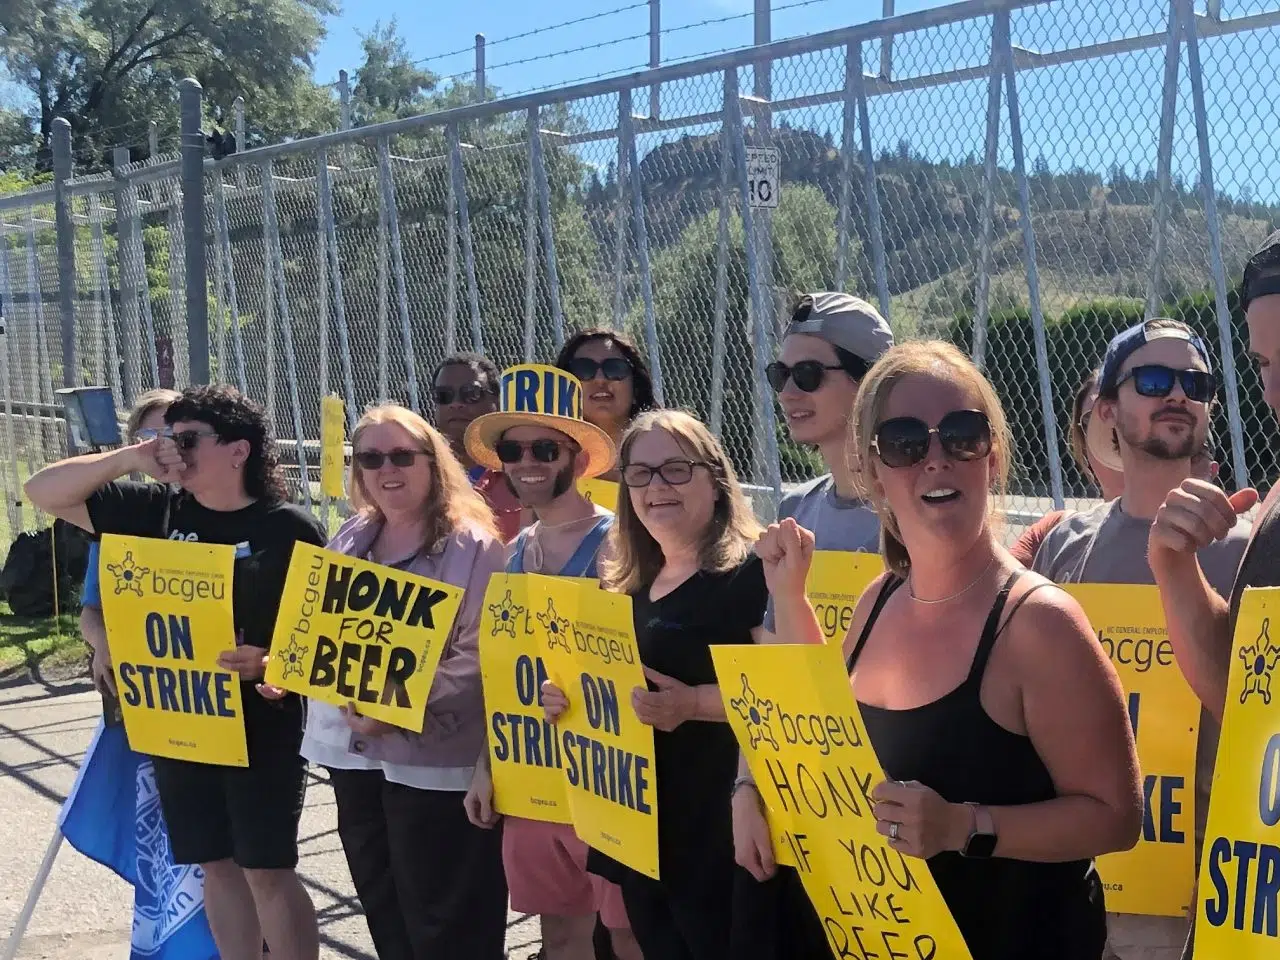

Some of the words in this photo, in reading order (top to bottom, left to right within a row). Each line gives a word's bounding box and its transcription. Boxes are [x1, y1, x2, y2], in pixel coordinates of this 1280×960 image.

[502, 370, 582, 419] TRIK
[153, 570, 225, 602] bcgeu
[294, 554, 324, 635] bcgeu
[321, 563, 448, 630] HONK
[145, 612, 194, 660] ON
[338, 617, 394, 645] FOR
[572, 623, 635, 665] bcgeu
[1098, 630, 1174, 672] bcge
[120, 662, 236, 718] STRIKE
[309, 635, 417, 709] BEER
[581, 672, 620, 736] ON
[776, 703, 863, 755] bcgeu
[492, 712, 562, 769] STRI
[563, 730, 651, 815] STRIKE
[765, 758, 879, 822] HONK
[784, 830, 812, 874] IF
[838, 838, 922, 894] YOU
[830, 885, 910, 923] LIKE
